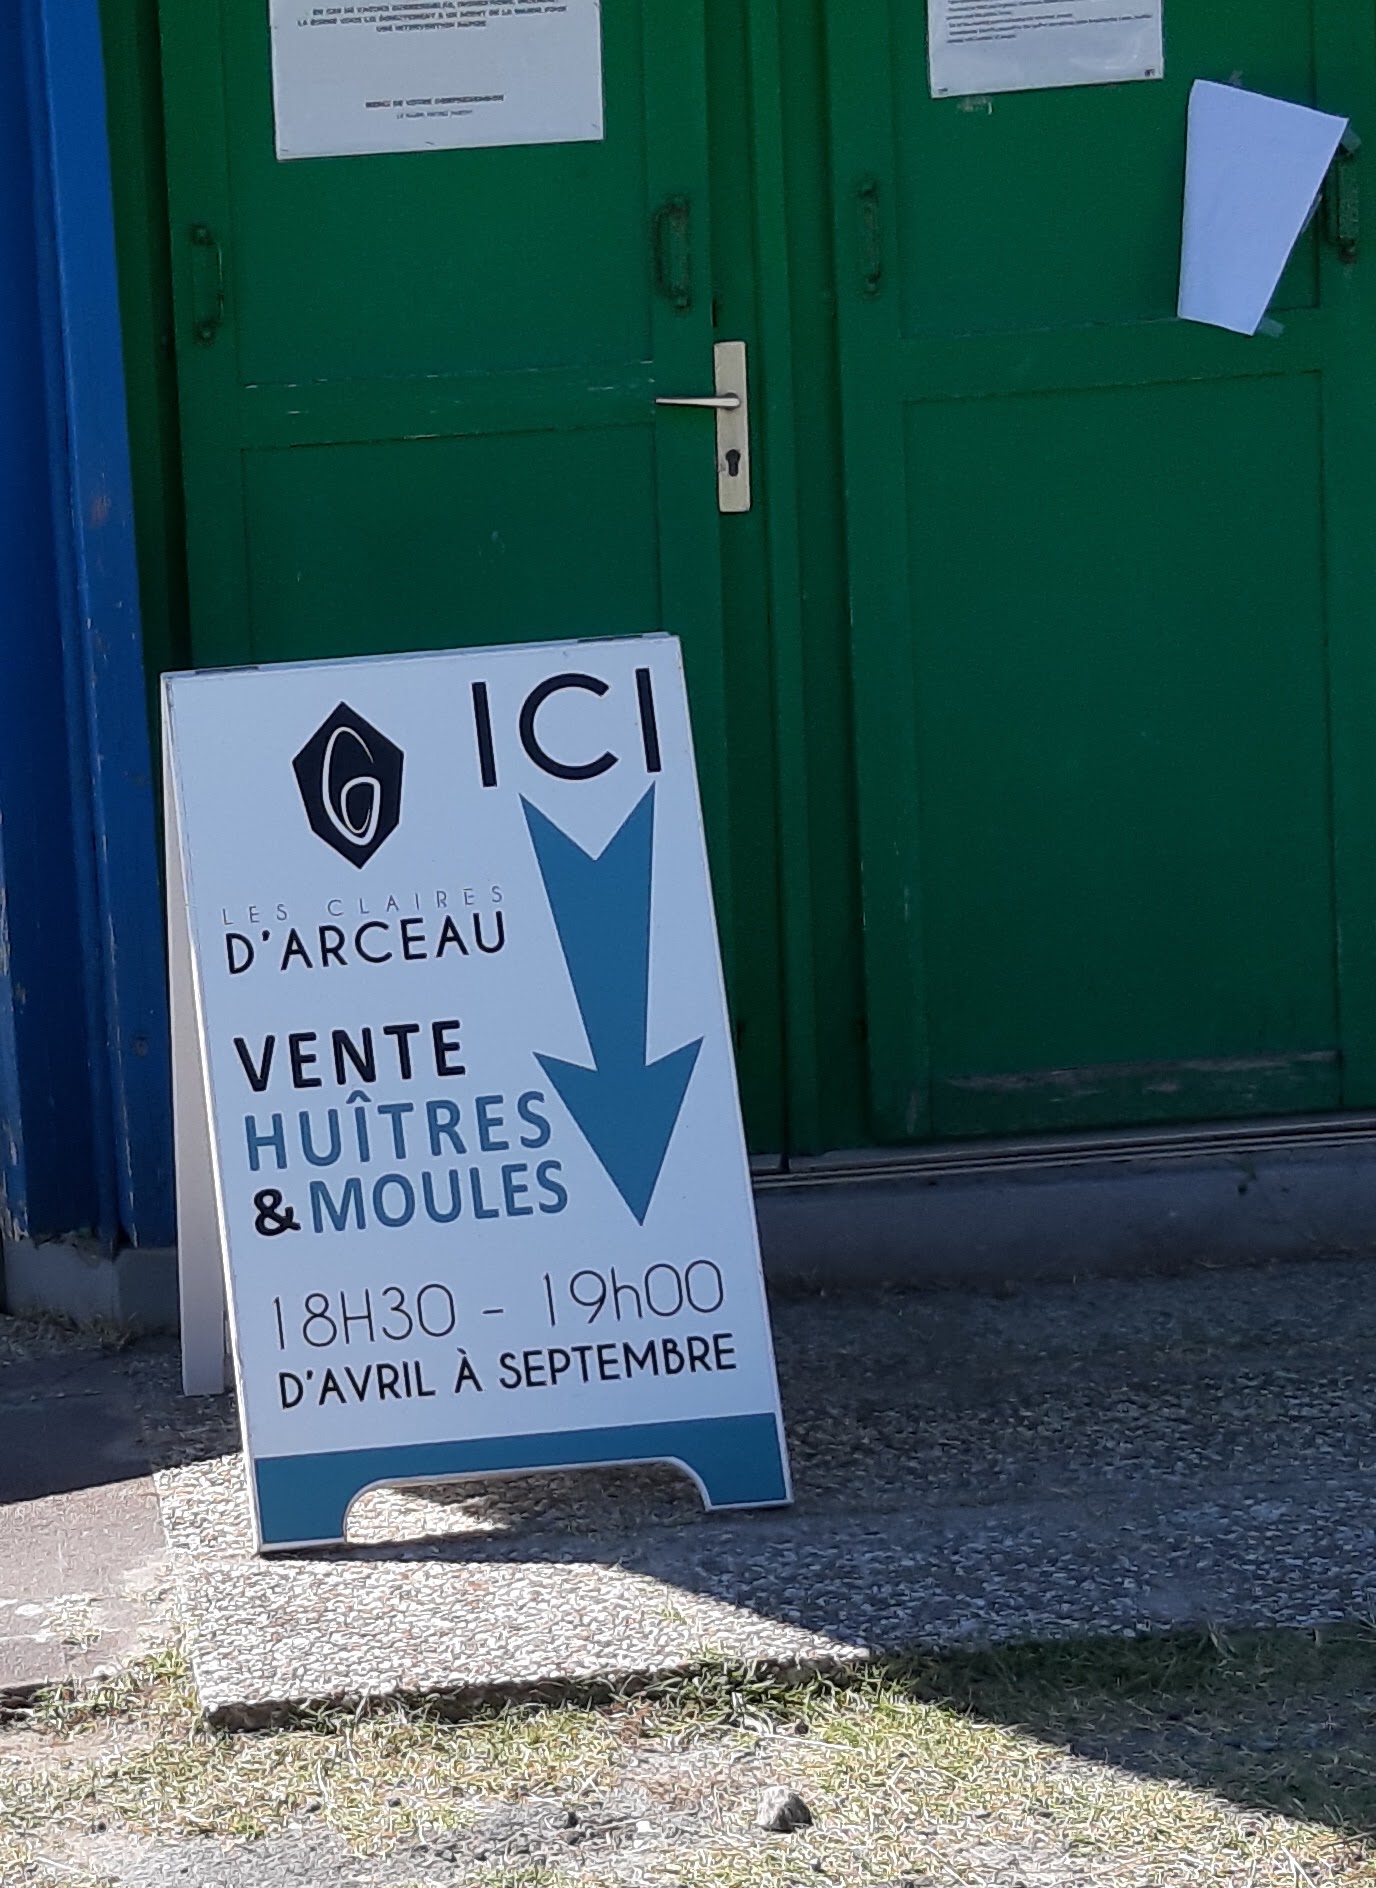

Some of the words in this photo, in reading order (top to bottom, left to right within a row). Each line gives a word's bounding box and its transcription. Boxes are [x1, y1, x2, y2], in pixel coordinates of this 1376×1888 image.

[470, 667, 663, 789] ICI
[222, 903, 288, 926] LES
[327, 885, 503, 917] CLAIRES
[225, 910, 506, 976] D'ARCEAU
[232, 1019, 467, 1093] VENTE
[244, 1090, 552, 1172] HUÎTRES
[273, 1283, 456, 1351] 18H30
[542, 1259, 724, 1329] 19h00
[278, 1359, 437, 1410] D'AVRIL
[454, 1346, 484, 1394] À
[498, 1332, 737, 1390] SEPTEMBRE
